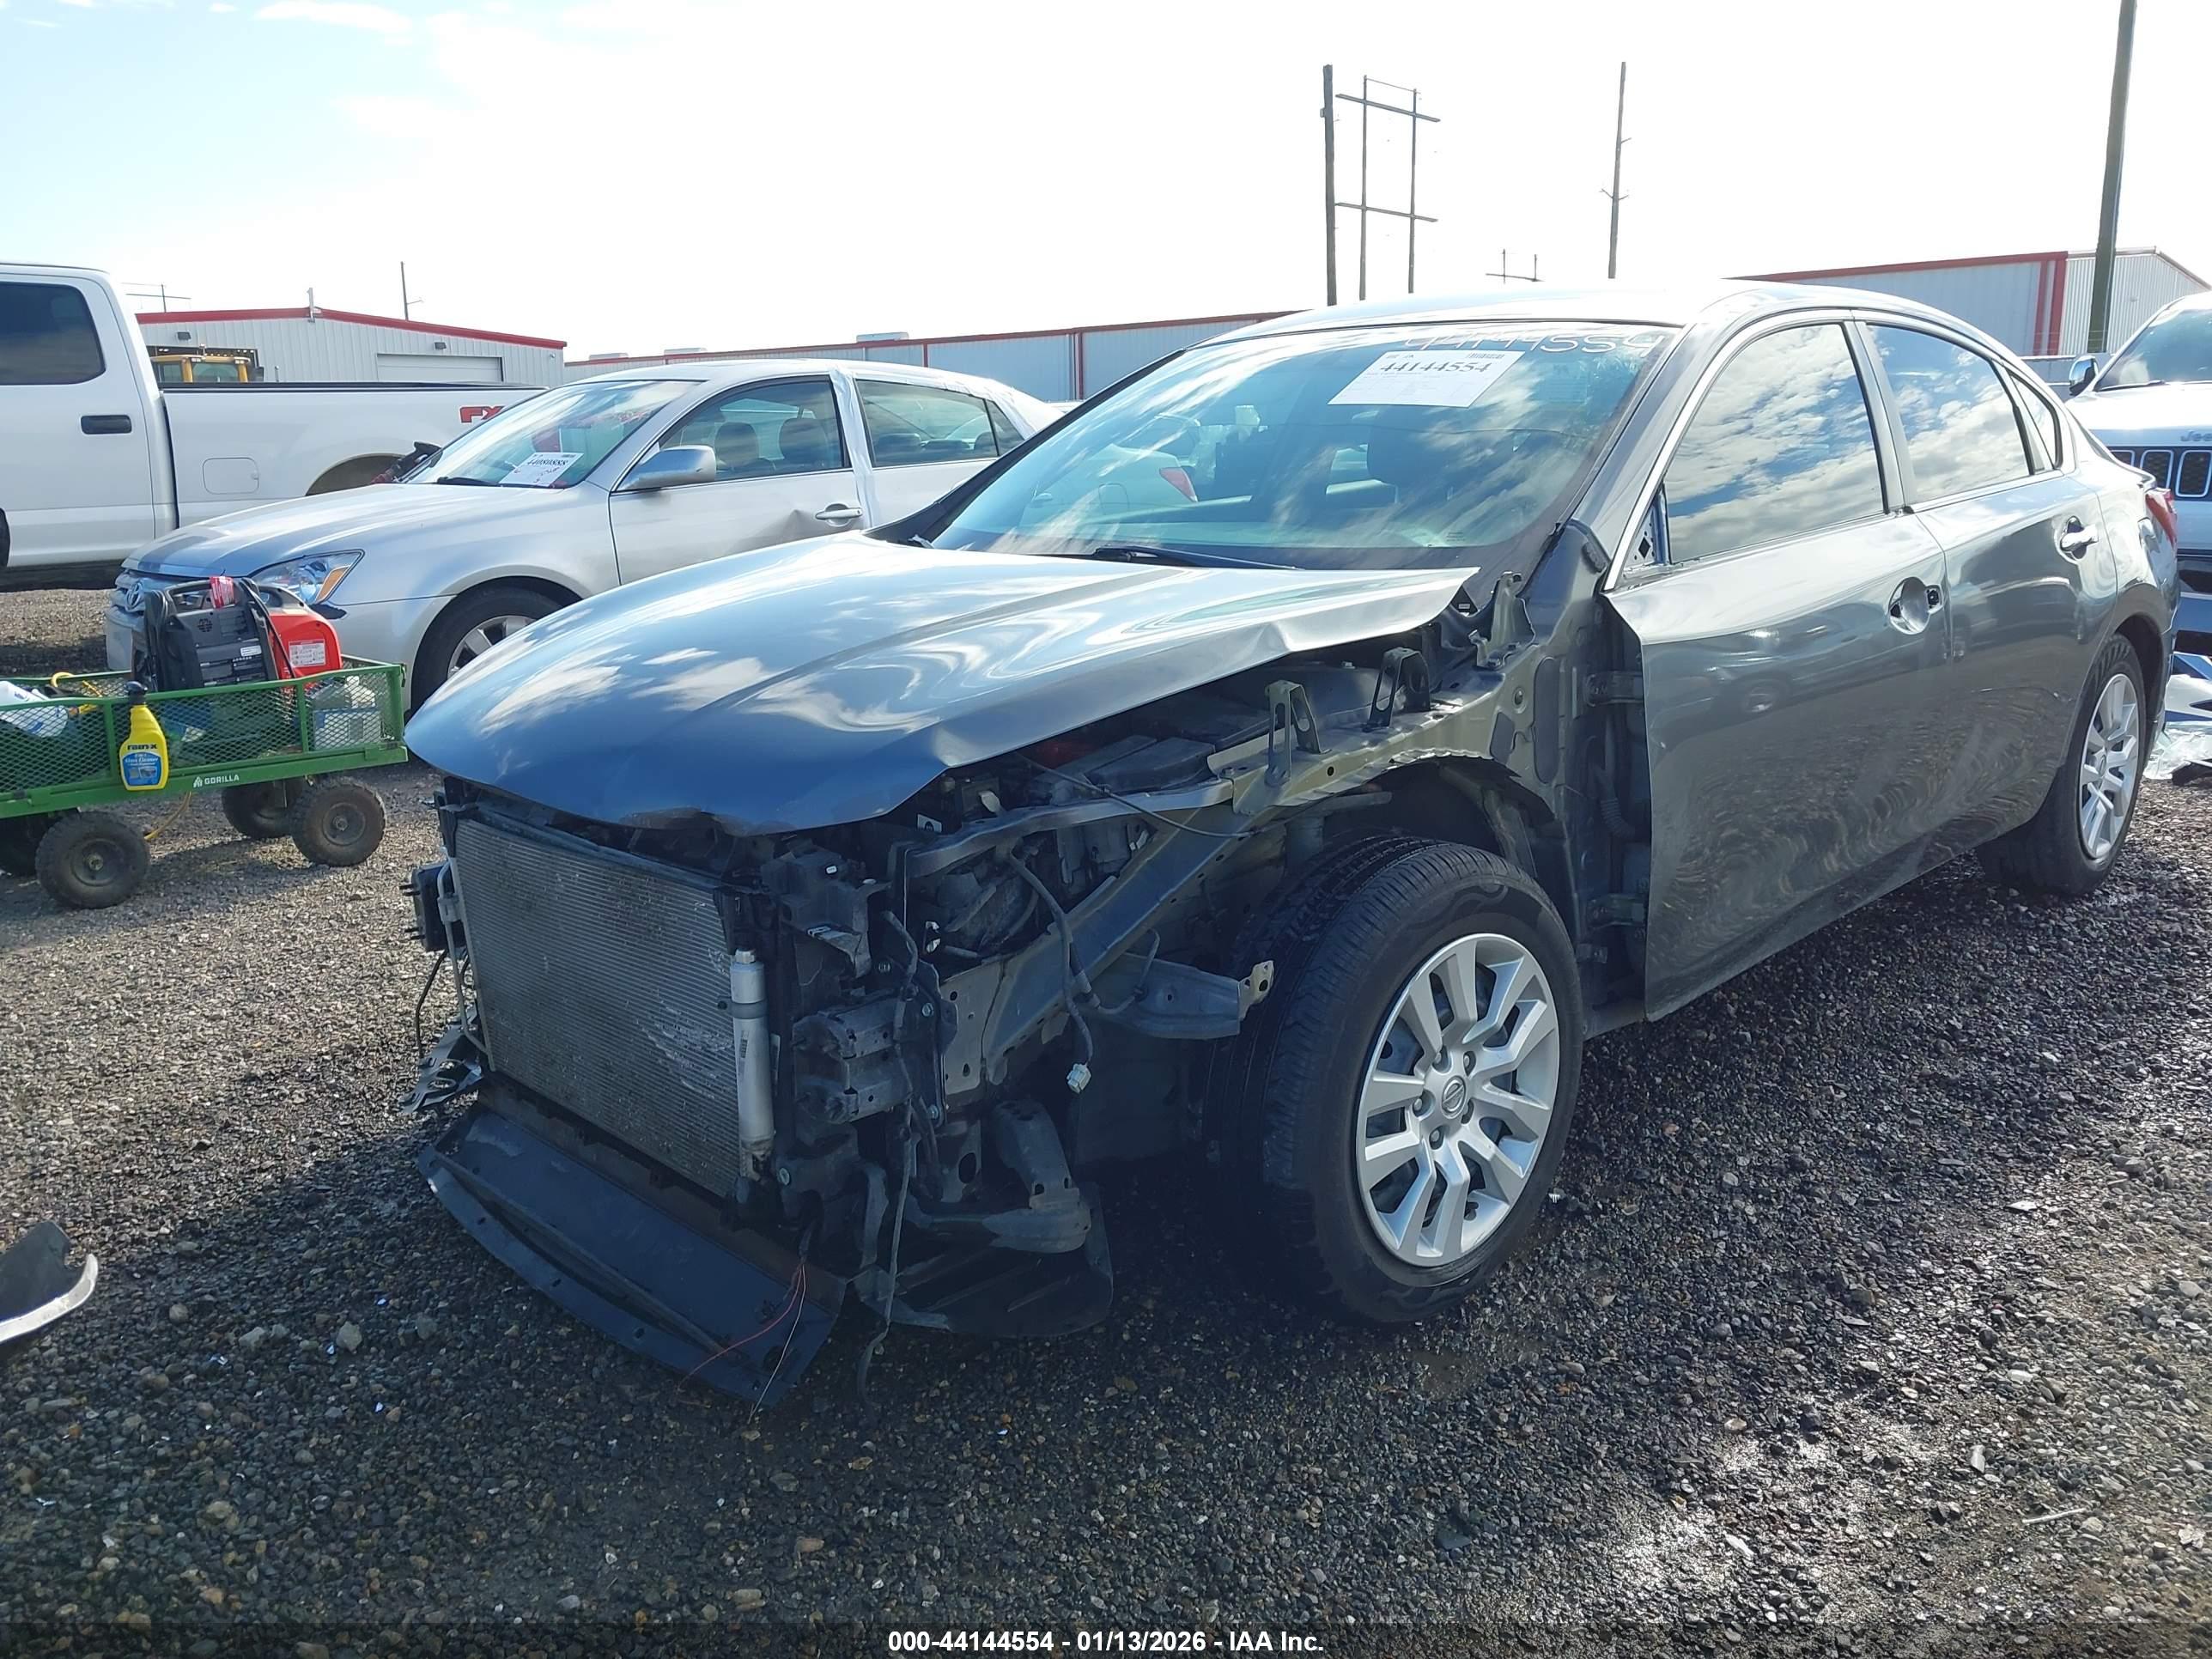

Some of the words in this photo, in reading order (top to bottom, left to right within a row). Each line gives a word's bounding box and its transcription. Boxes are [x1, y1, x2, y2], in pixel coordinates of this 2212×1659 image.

[1380, 361, 1492, 373] 44144554
[459, 405, 505, 422] FX
[2180, 430, 2212, 442] Jee
[204, 774, 240, 785] GORILLA
